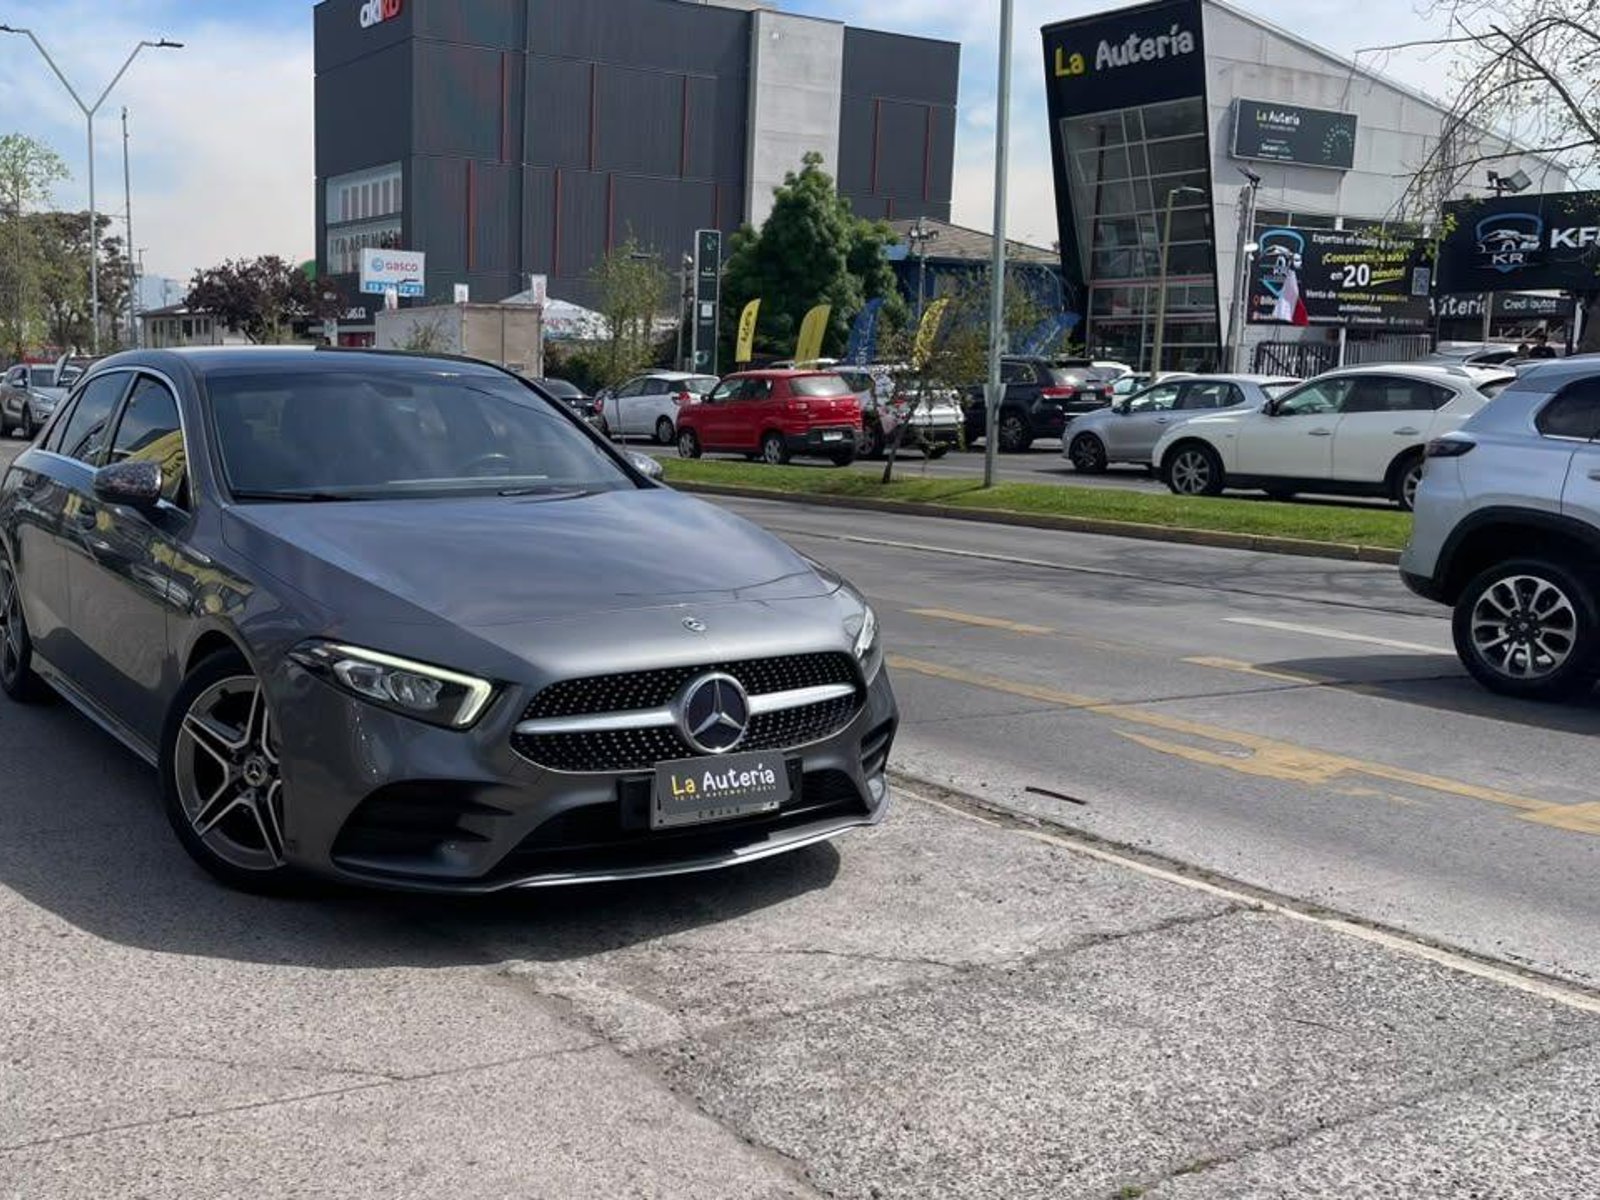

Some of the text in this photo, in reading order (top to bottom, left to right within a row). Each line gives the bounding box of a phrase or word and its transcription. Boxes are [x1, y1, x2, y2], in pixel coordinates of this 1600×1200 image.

[1055, 23, 1195, 76] La Autería
[1256, 109, 1267, 121] La
[1492, 253, 1525, 265] KR
[385, 260, 418, 273] gasco
[1330, 271, 1344, 281] en
[1342, 263, 1371, 288] 20
[1306, 289, 1327, 299] Venta
[1327, 290, 1337, 299] de
[671, 775, 696, 796] La
[703, 762, 776, 792] Autería
